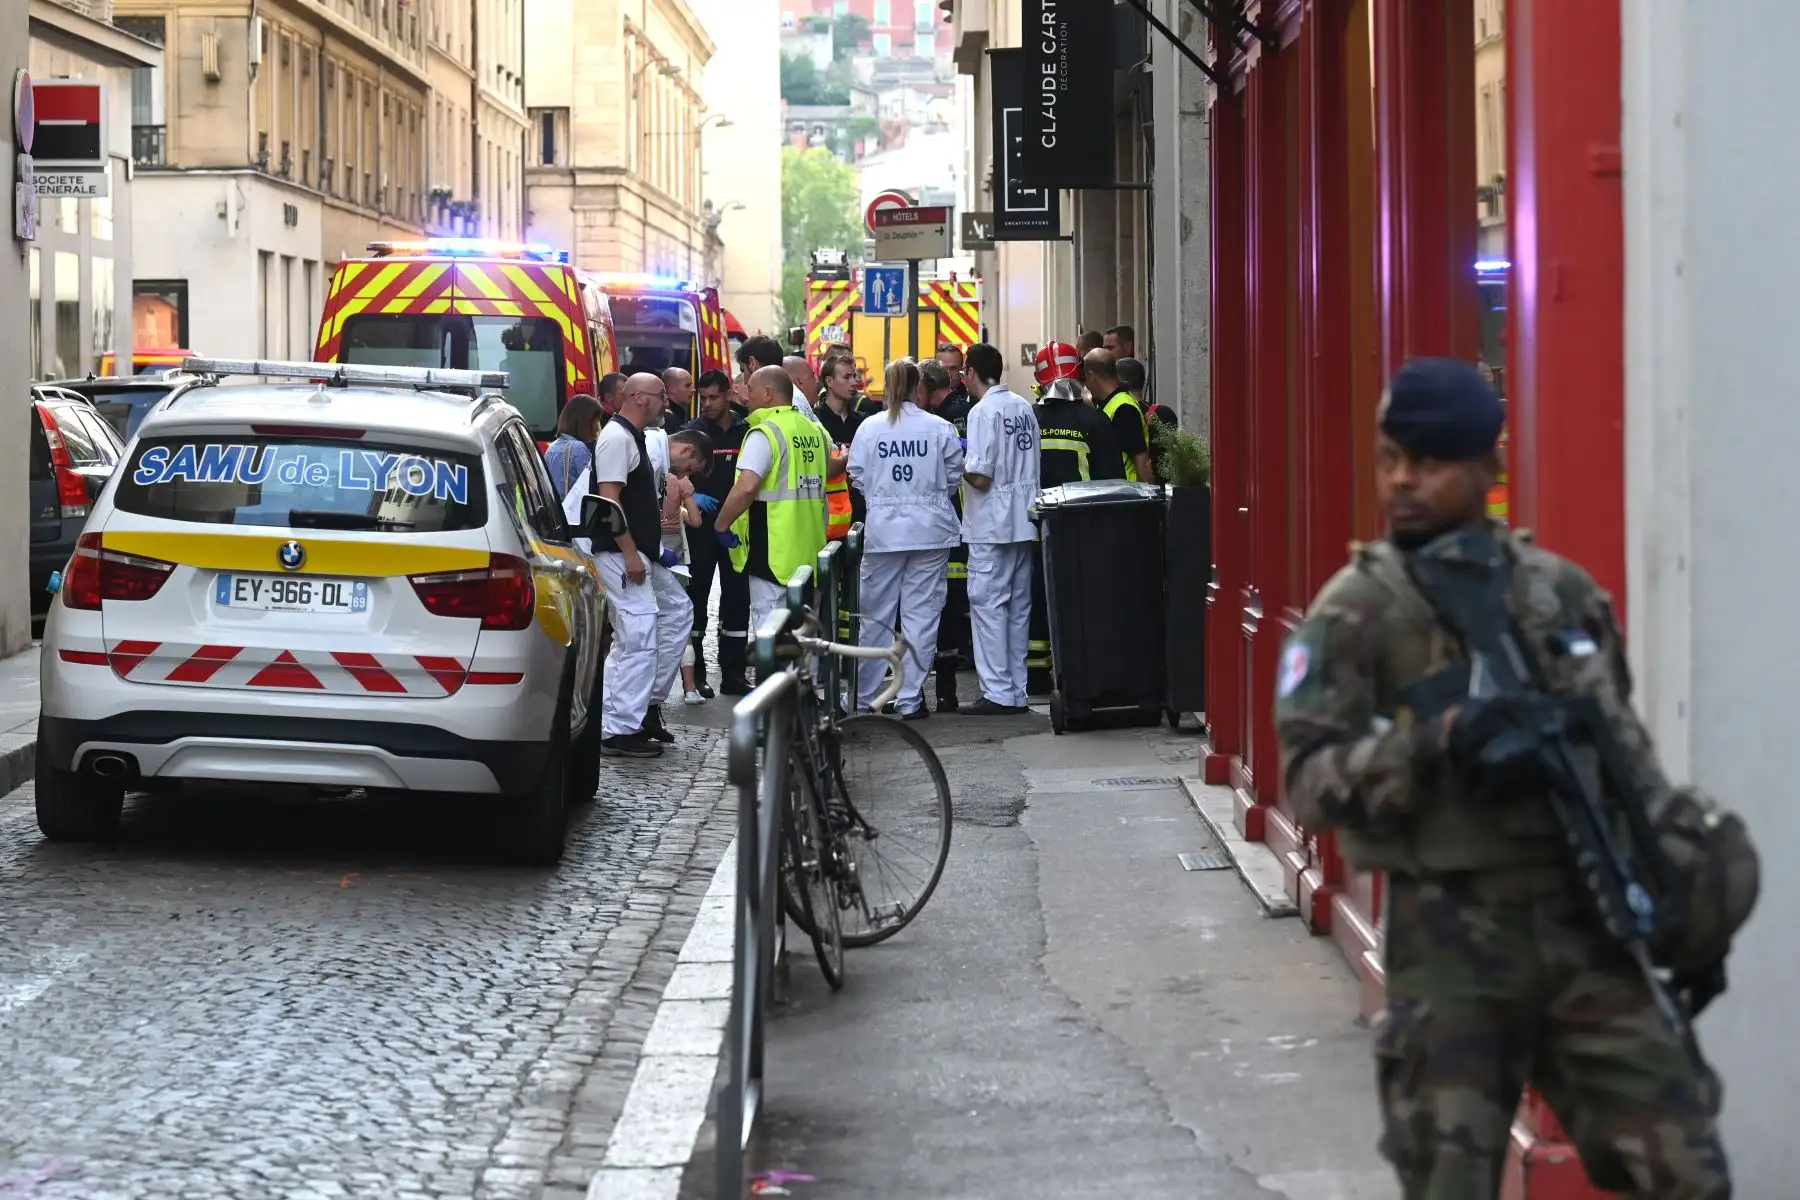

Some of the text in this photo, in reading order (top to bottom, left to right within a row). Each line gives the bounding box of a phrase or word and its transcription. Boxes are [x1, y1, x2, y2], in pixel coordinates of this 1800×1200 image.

[1041, 63, 1057, 148] CLAUDE
[33, 176, 84, 184] SOCIETE
[792, 435, 820, 449] SAMU
[878, 439, 928, 459] SAMU
[802, 450, 815, 463] 69
[133, 444, 468, 505] SAMU de LYON
[892, 464, 913, 482] 69
[235, 578, 349, 607] EY-966-DL
[352, 596, 366, 609] 69
